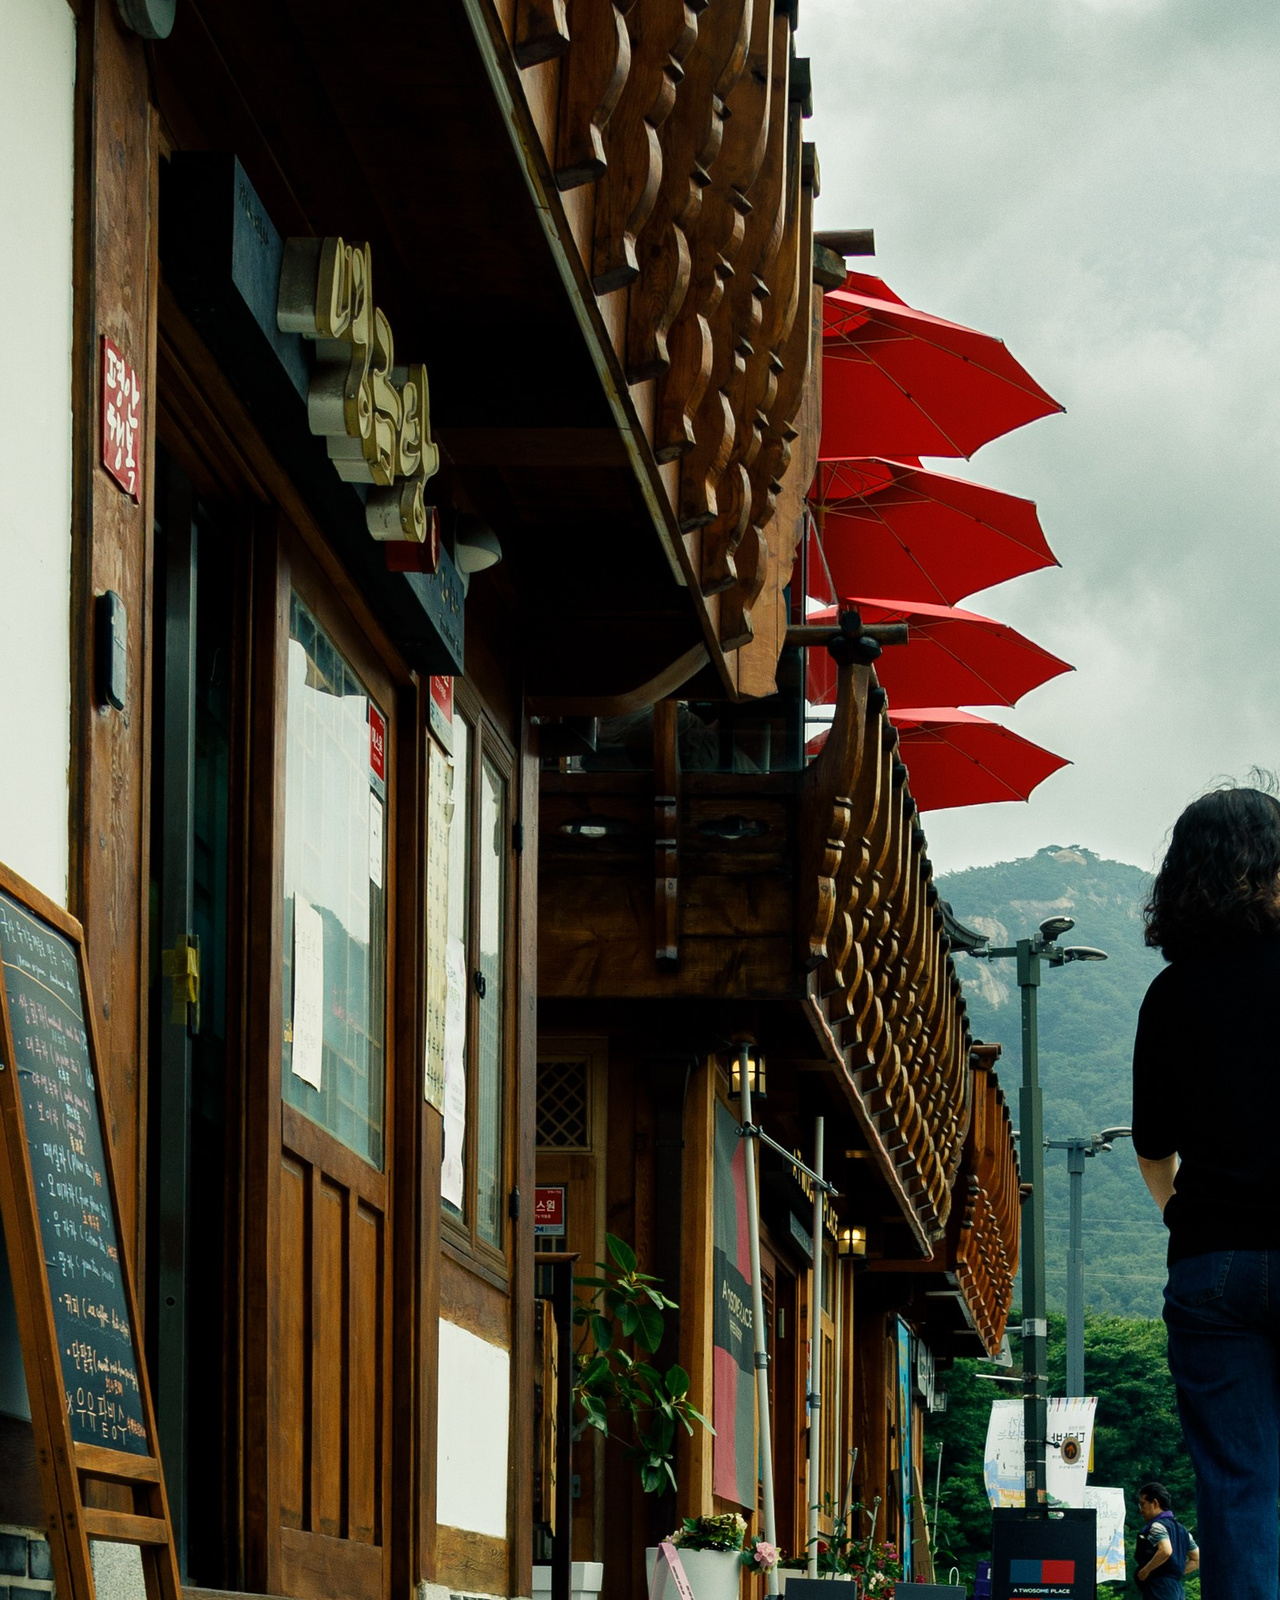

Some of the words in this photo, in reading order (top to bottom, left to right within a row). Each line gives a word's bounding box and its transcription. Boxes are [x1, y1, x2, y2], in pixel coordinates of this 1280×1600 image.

[107, 348, 140, 430] 평안
[25, 1035, 48, 1063] 대추차
[37, 1101, 59, 1132] 보이차
[43, 1143, 67, 1174] 매실차
[47, 1173, 76, 1208] 오미자차
[53, 1211, 77, 1242] 유자차
[63, 1293, 81, 1319] 커피
[71, 1339, 94, 1377] 단팥죽
